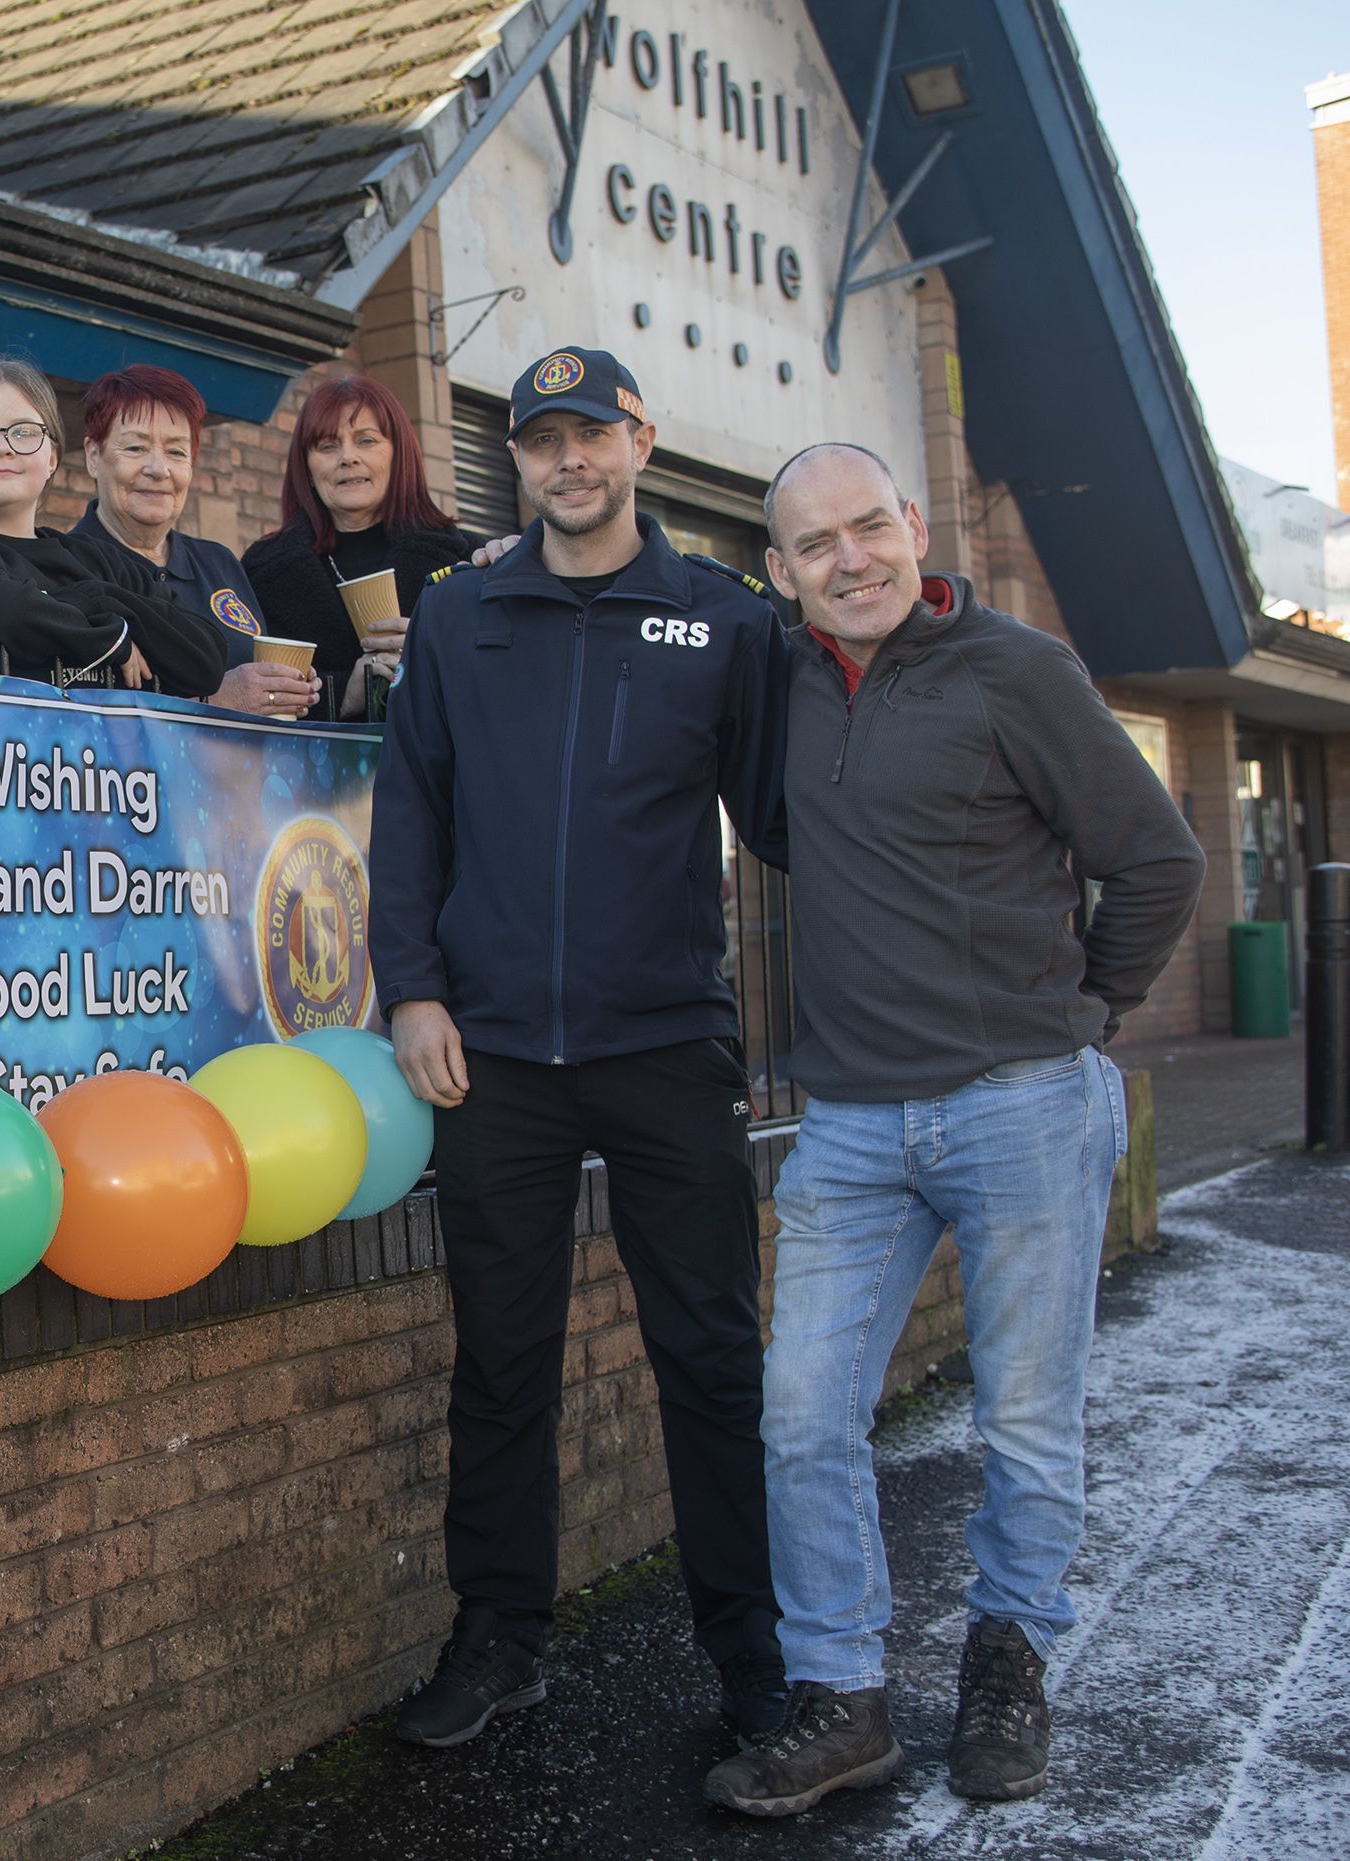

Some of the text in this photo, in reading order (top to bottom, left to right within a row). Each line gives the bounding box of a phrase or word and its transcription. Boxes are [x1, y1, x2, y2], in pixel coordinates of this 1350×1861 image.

[639, 616, 710, 648] CRS
[89, 850, 229, 916] Darren
[271, 843, 364, 948] COMMUNITY RESCUE
[83, 951, 189, 1015] Luck
[293, 995, 353, 1031] SERVICE
